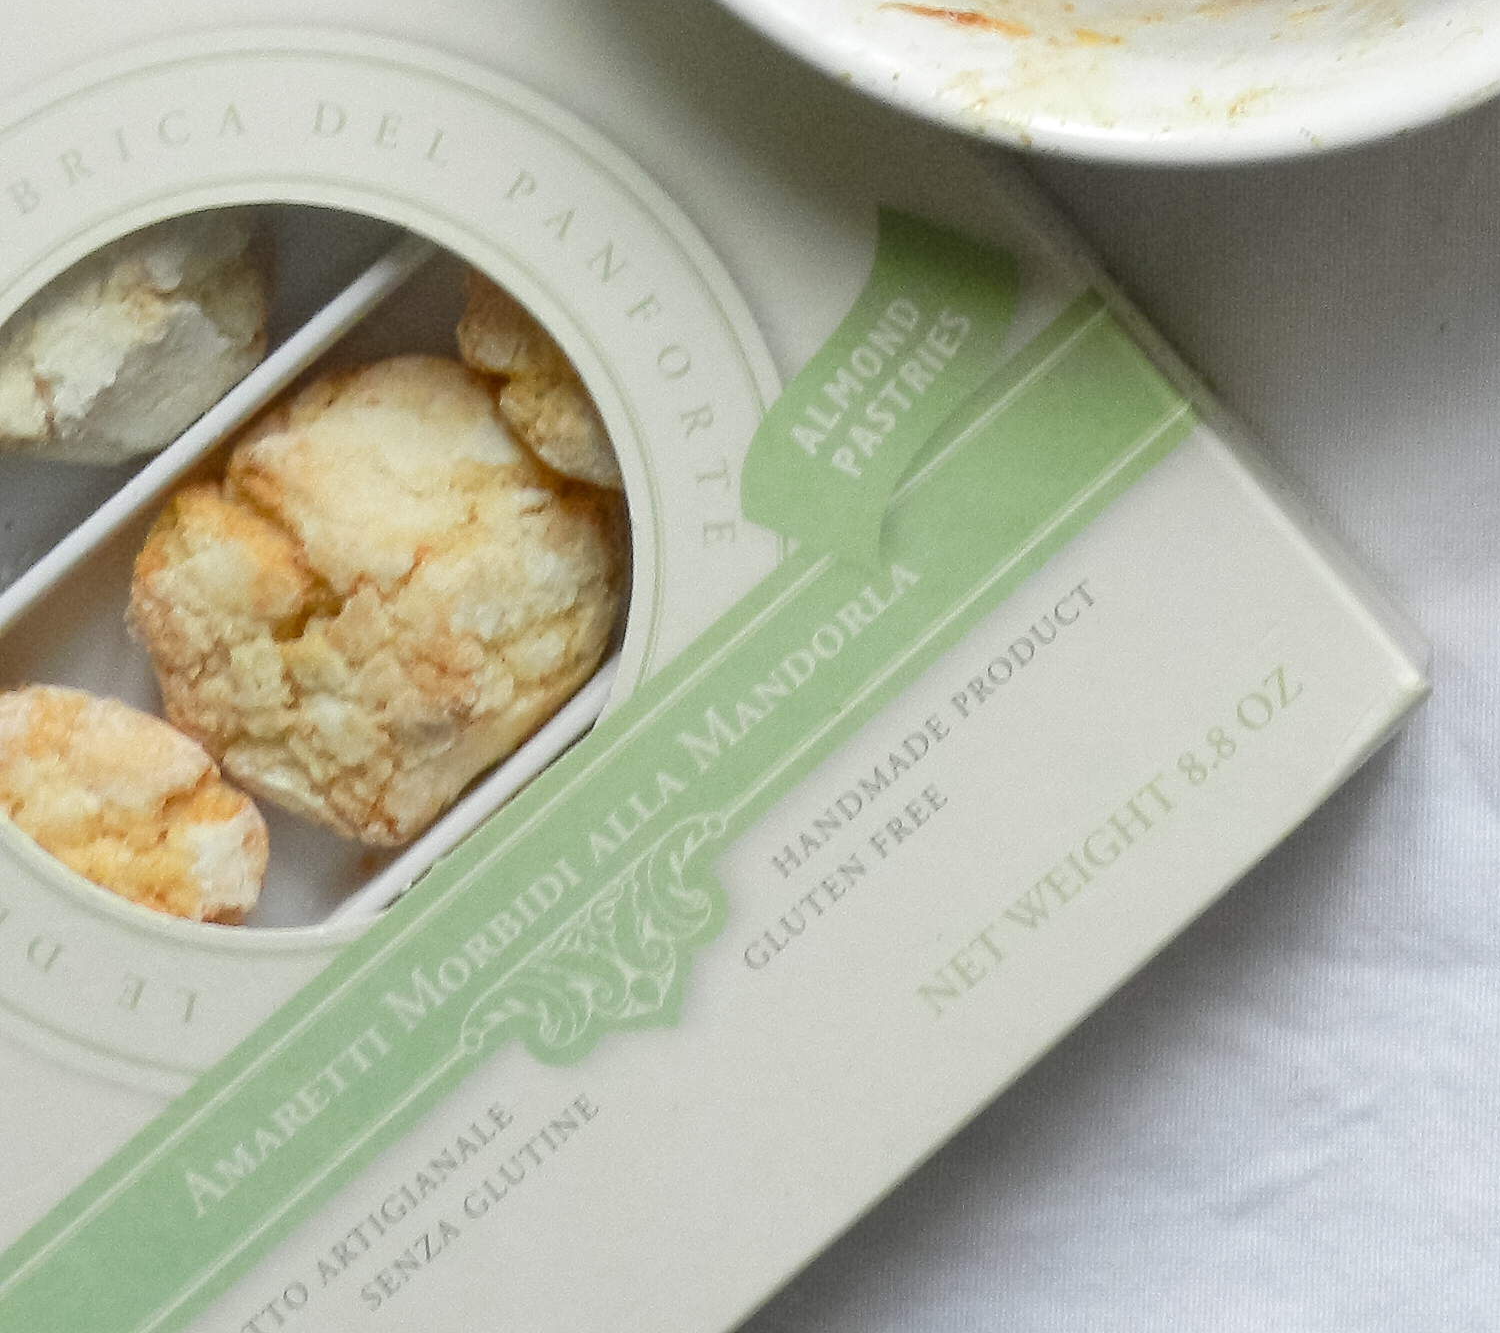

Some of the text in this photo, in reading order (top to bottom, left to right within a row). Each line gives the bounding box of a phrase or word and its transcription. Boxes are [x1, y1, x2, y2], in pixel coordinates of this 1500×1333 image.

[313, 101, 449, 169] DEL
[505, 169, 738, 549] PANFORTE
[790, 295, 922, 460] ALMOND
[830, 309, 971, 478] PASTRIES
[770, 578, 1100, 879] HANDMADE PRODUCT
[179, 559, 922, 1217] AMARETTI MORBIDI ALLA MANDORLA
[742, 783, 950, 973] GLUTEN FREE
[915, 664, 1305, 1020] NET WEIGHT 8.8 OZ
[316, 1101, 517, 1288] ARTIGIANALE
[359, 1094, 601, 1314] SENZA GLUTINE
